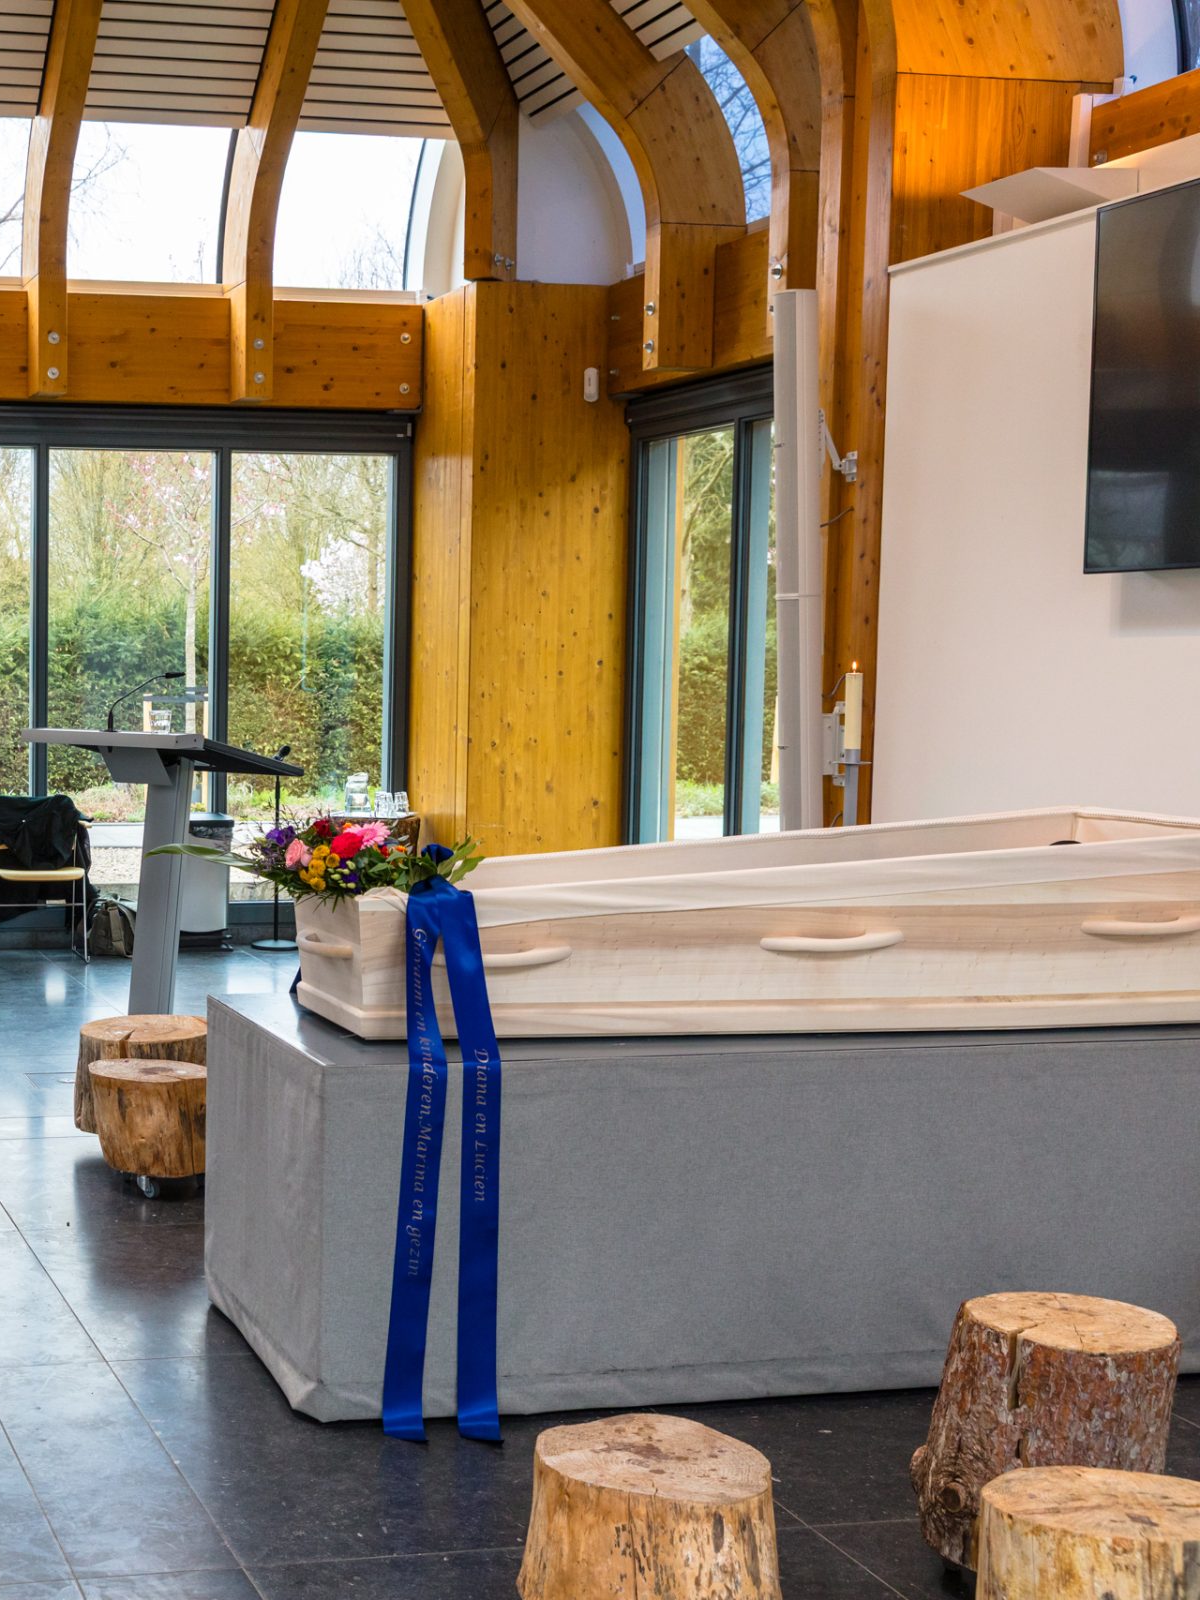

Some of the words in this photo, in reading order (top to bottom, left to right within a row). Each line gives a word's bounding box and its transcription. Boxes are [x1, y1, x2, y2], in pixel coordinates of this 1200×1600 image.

[474, 1048, 491, 1106] Diana
[475, 1112, 487, 1134] en
[474, 1140, 489, 1203] Lucien
[412, 1199, 423, 1220] en
[406, 1224, 422, 1276] gezin
